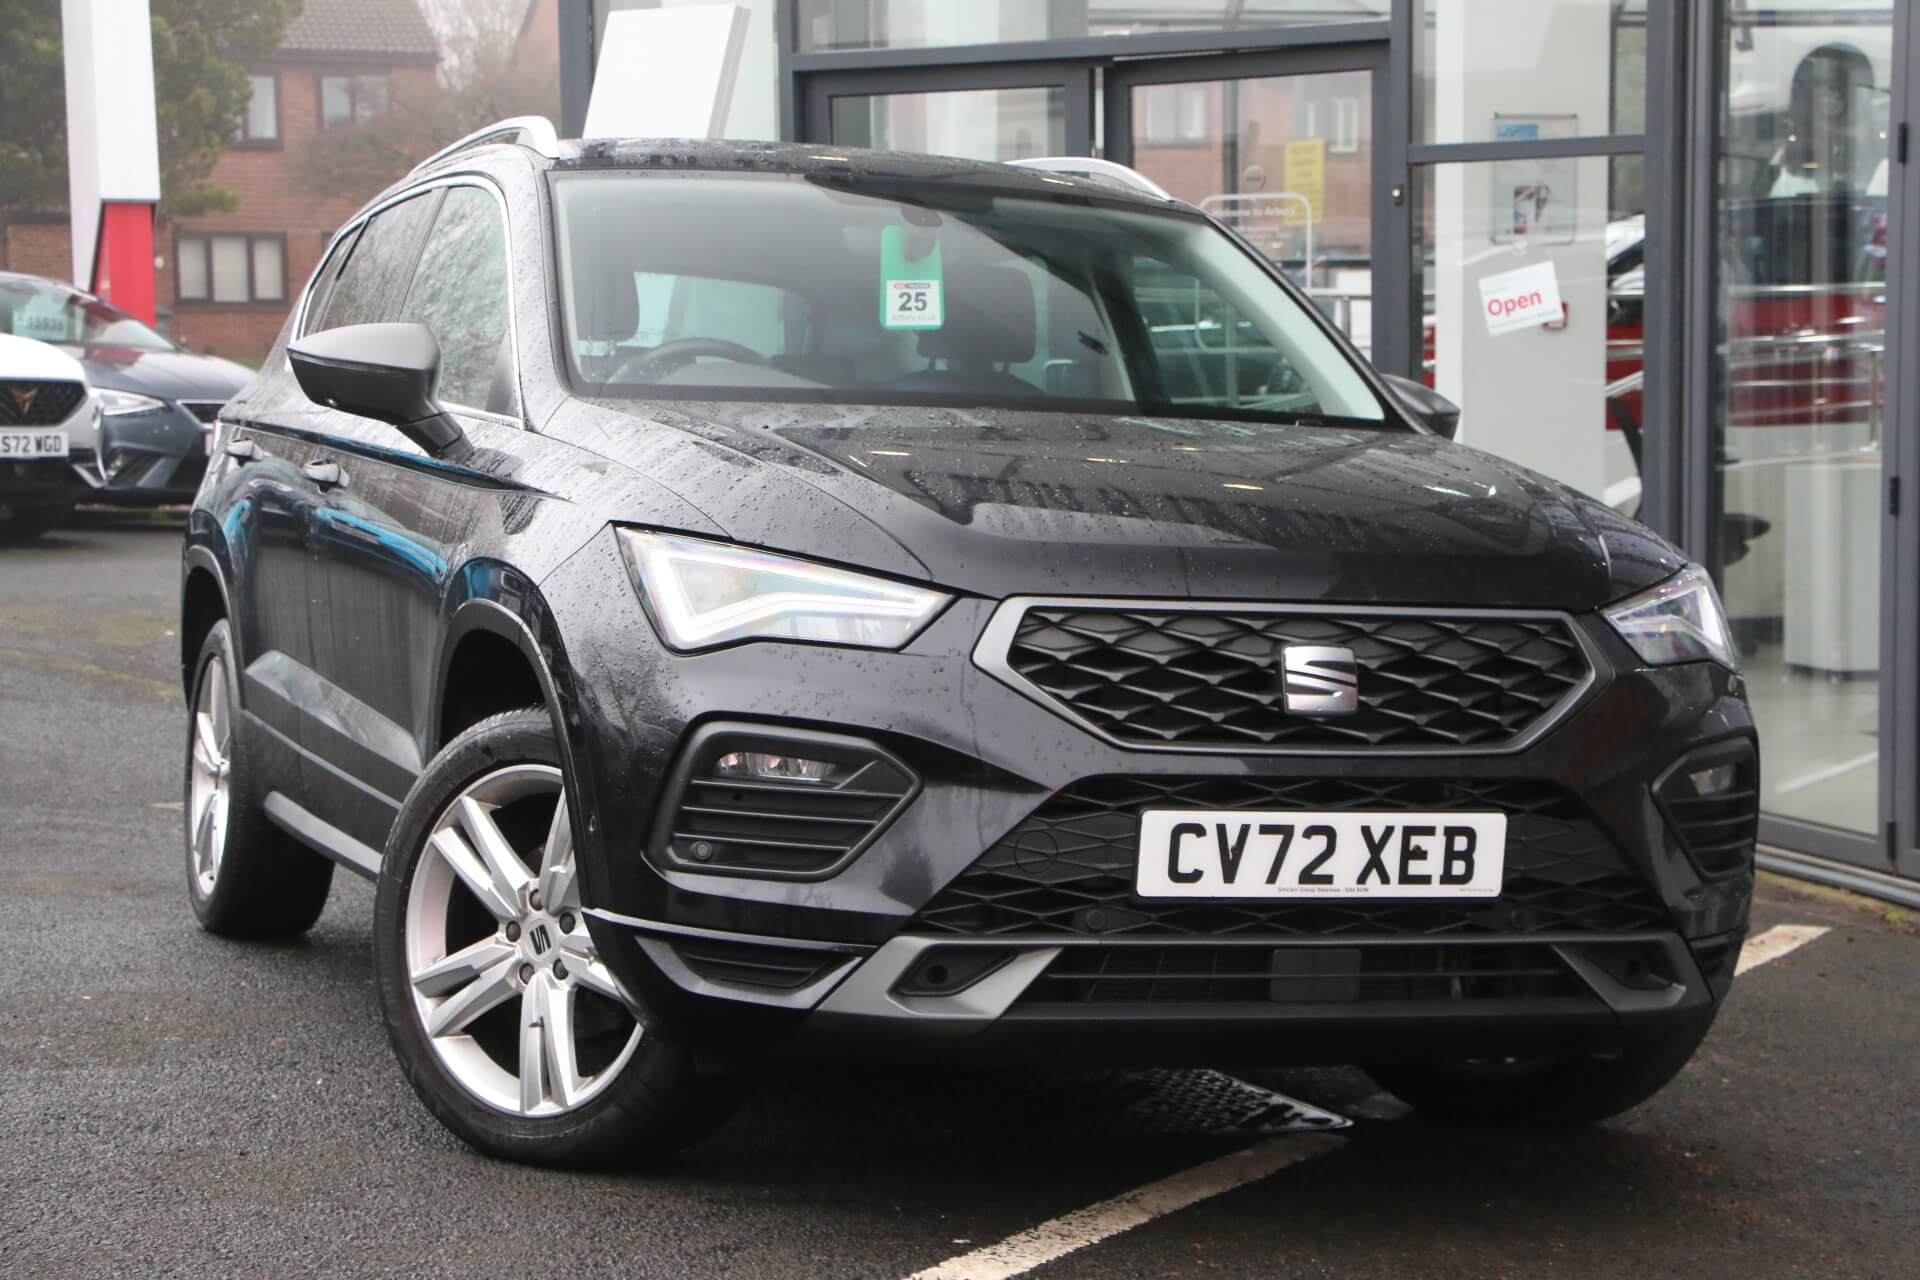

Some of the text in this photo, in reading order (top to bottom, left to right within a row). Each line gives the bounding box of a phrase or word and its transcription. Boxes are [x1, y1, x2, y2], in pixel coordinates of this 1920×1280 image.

[898, 291, 928, 312] 25
[1486, 289, 1542, 317] Open
[0, 435, 31, 453] S72
[1167, 822, 1477, 886] CV72 XEB
